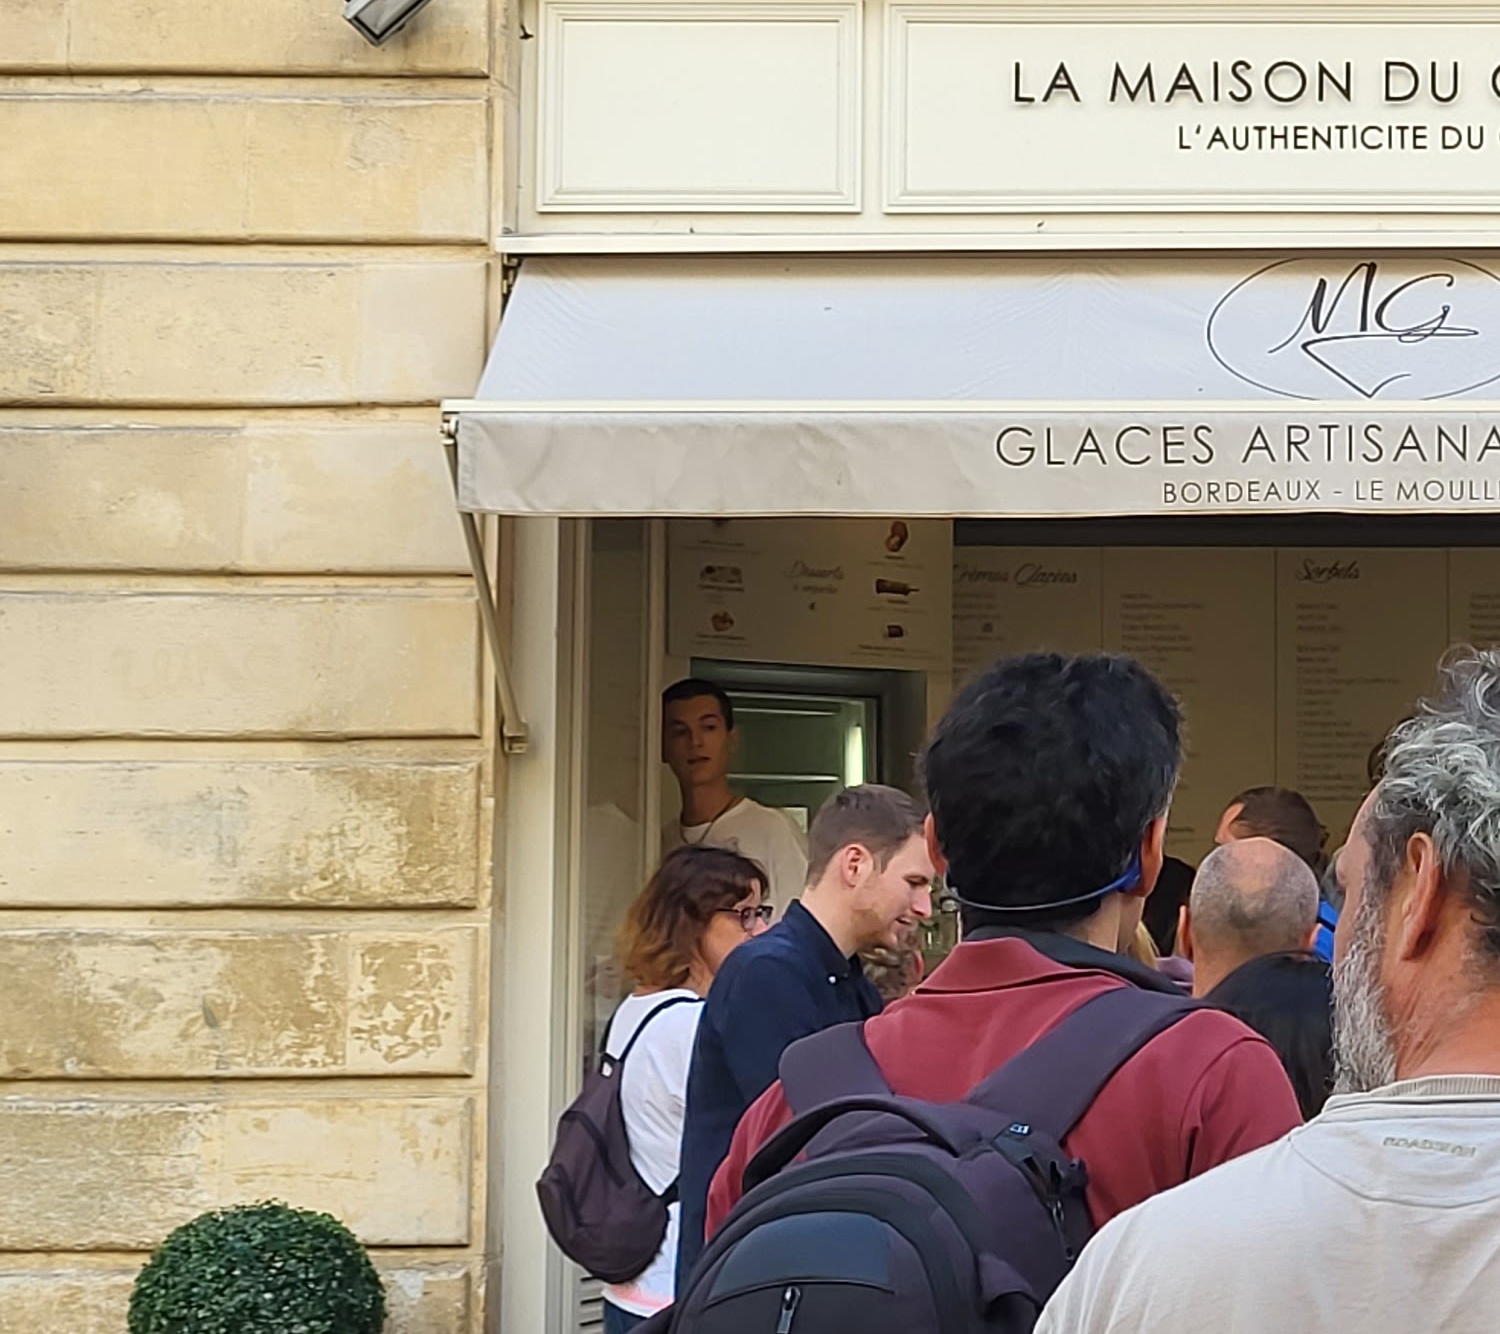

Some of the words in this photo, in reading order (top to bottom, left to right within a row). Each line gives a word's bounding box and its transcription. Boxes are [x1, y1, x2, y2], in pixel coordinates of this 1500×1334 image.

[1014, 61, 1081, 103] LA
[1109, 60, 1352, 103] MAISON
[1384, 61, 1459, 104] DU
[1178, 124, 1428, 151] L'AUTHENTICITE
[1441, 124, 1485, 150] DU
[996, 424, 1215, 467] GLACES
[1162, 479, 1321, 504] BORDEAUX
[1355, 479, 1384, 502] LE
